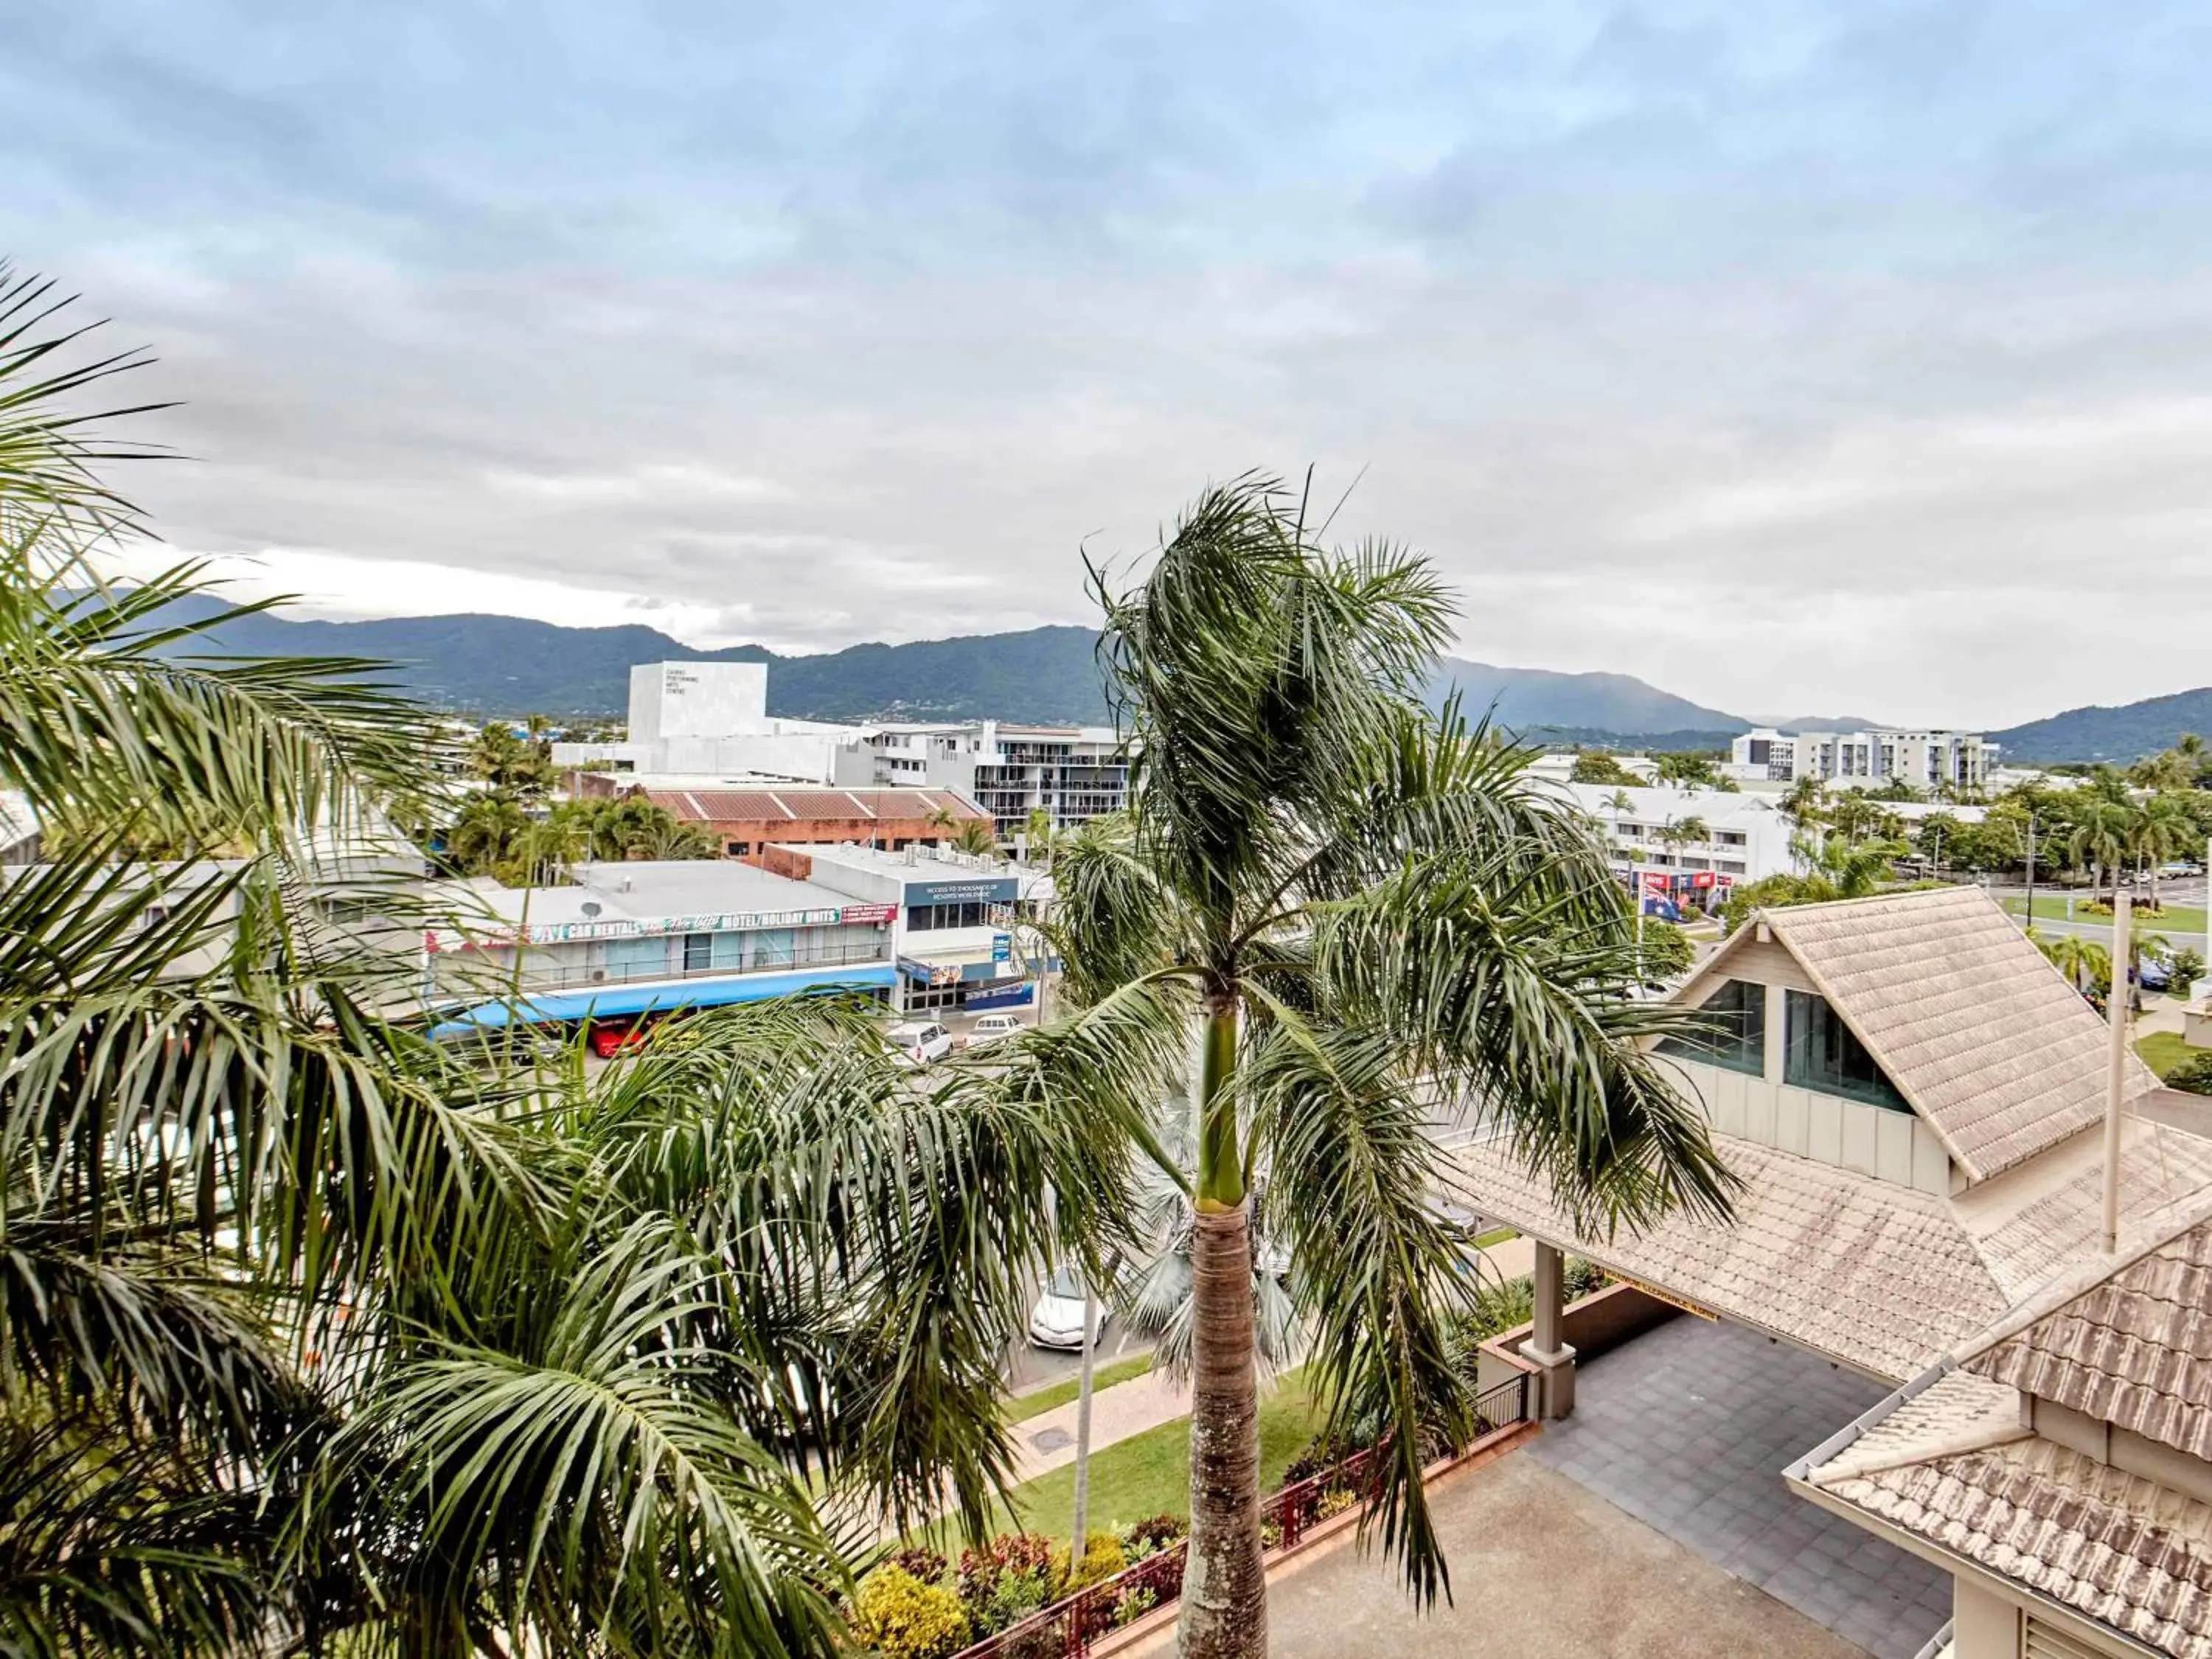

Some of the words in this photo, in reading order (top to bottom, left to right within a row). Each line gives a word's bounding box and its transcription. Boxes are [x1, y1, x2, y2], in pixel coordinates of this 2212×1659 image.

[722, 911, 804, 929] MOTEL/HOLIDAY
[806, 909, 835, 924] UNITS
[569, 924, 591, 939] CAR
[593, 922, 641, 937] RENTALS
